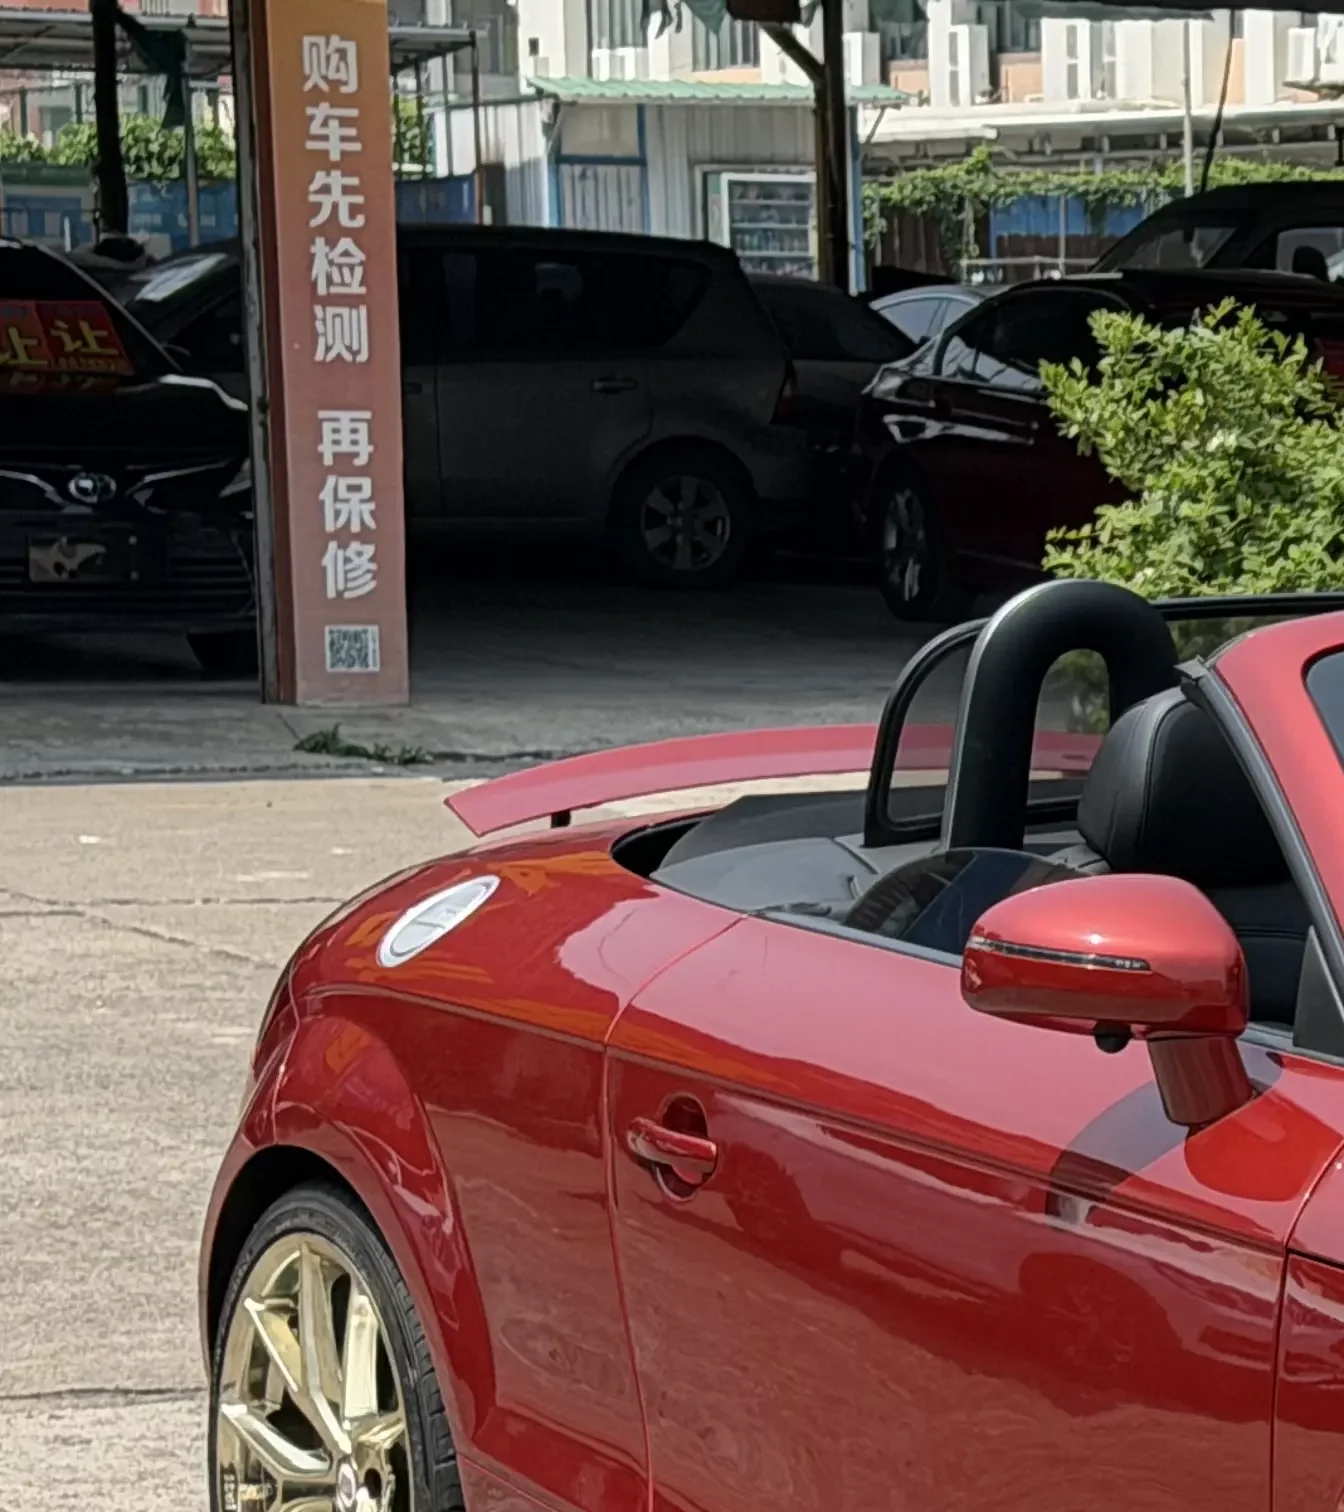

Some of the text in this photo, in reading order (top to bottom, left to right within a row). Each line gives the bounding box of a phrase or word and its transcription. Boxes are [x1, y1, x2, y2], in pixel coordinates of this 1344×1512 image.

[302, 34, 376, 599] 购车先检测 再保修
